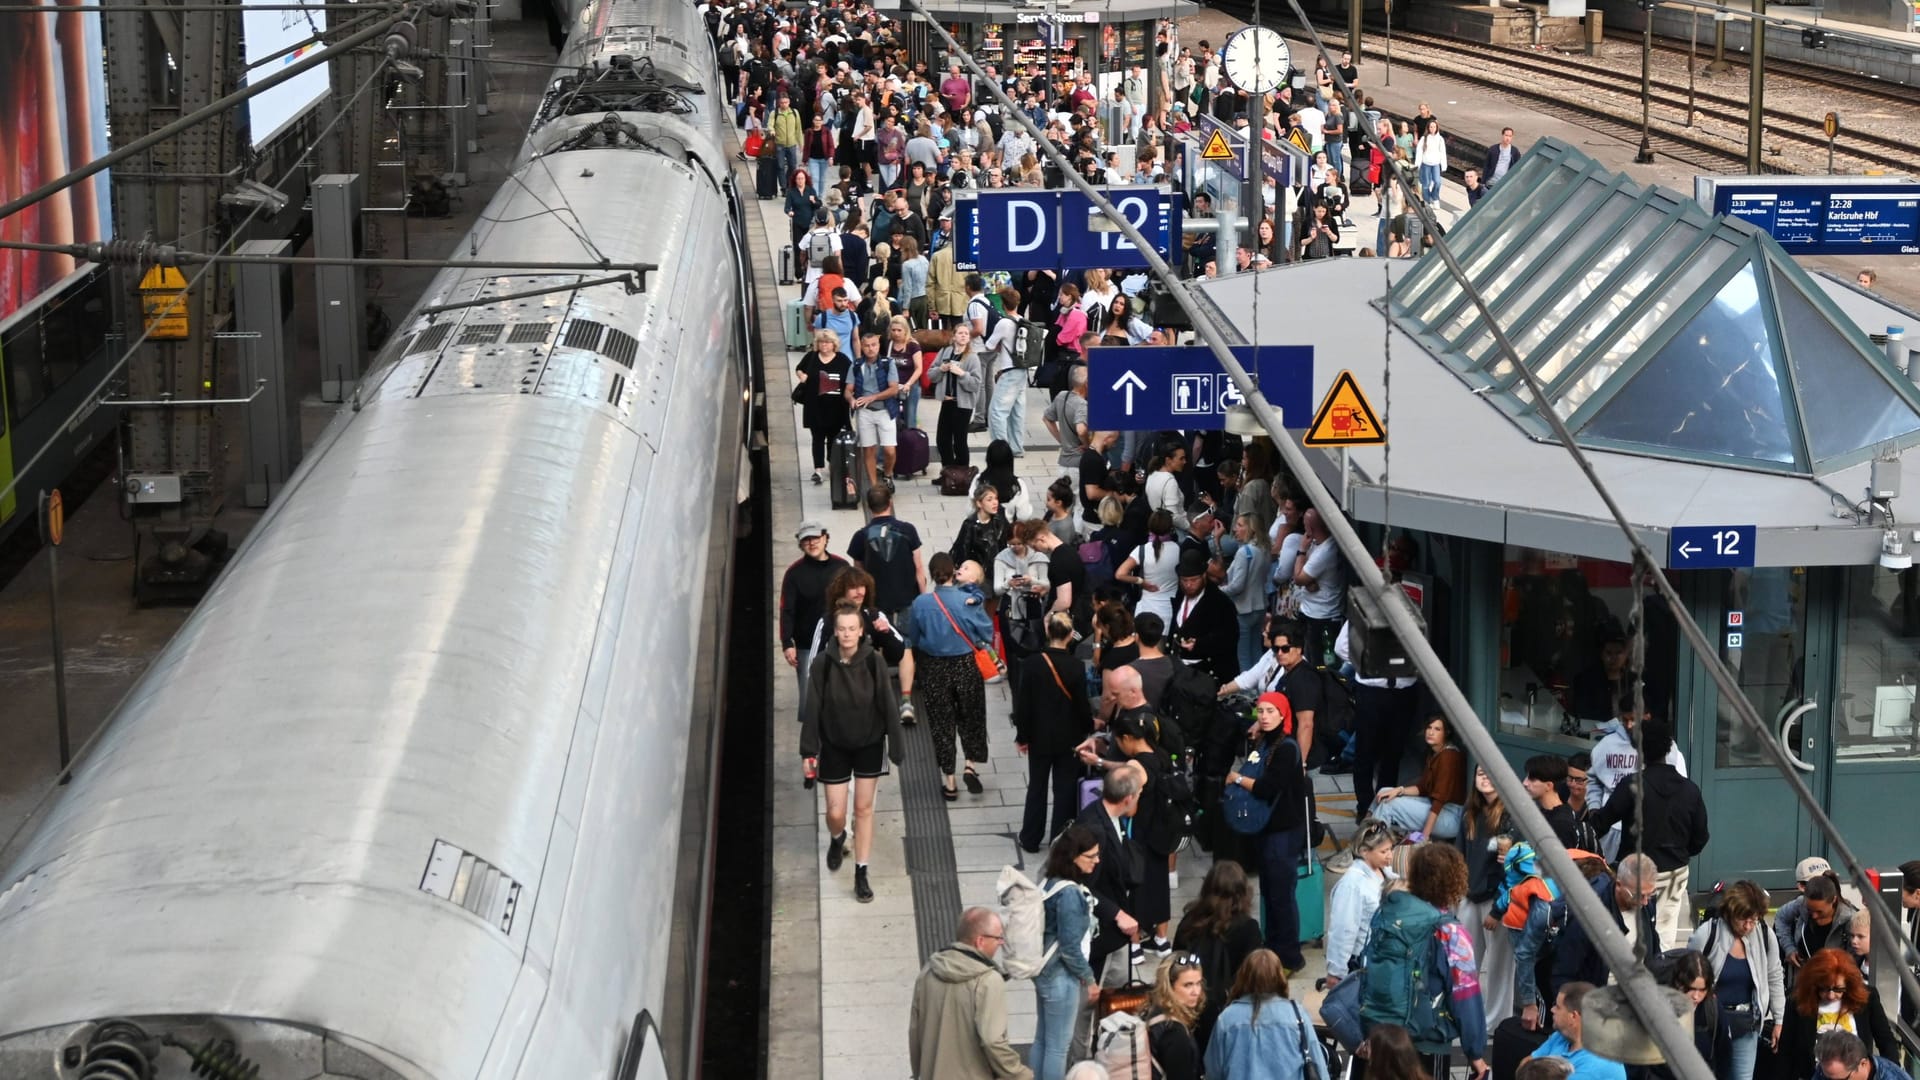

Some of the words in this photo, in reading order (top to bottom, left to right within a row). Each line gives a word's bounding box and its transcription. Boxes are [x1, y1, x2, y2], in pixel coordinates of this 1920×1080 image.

[1017, 13, 1083, 23] ServicStore
[1830, 200, 1853, 209] 12:28
[1828, 211, 1864, 220] Karlsruhe
[1864, 210, 1879, 220] Hbf
[1007, 200, 1047, 252] D
[1901, 245, 1920, 253] Gleis
[957, 262, 976, 270] Gleis
[1712, 531, 1740, 555] 12
